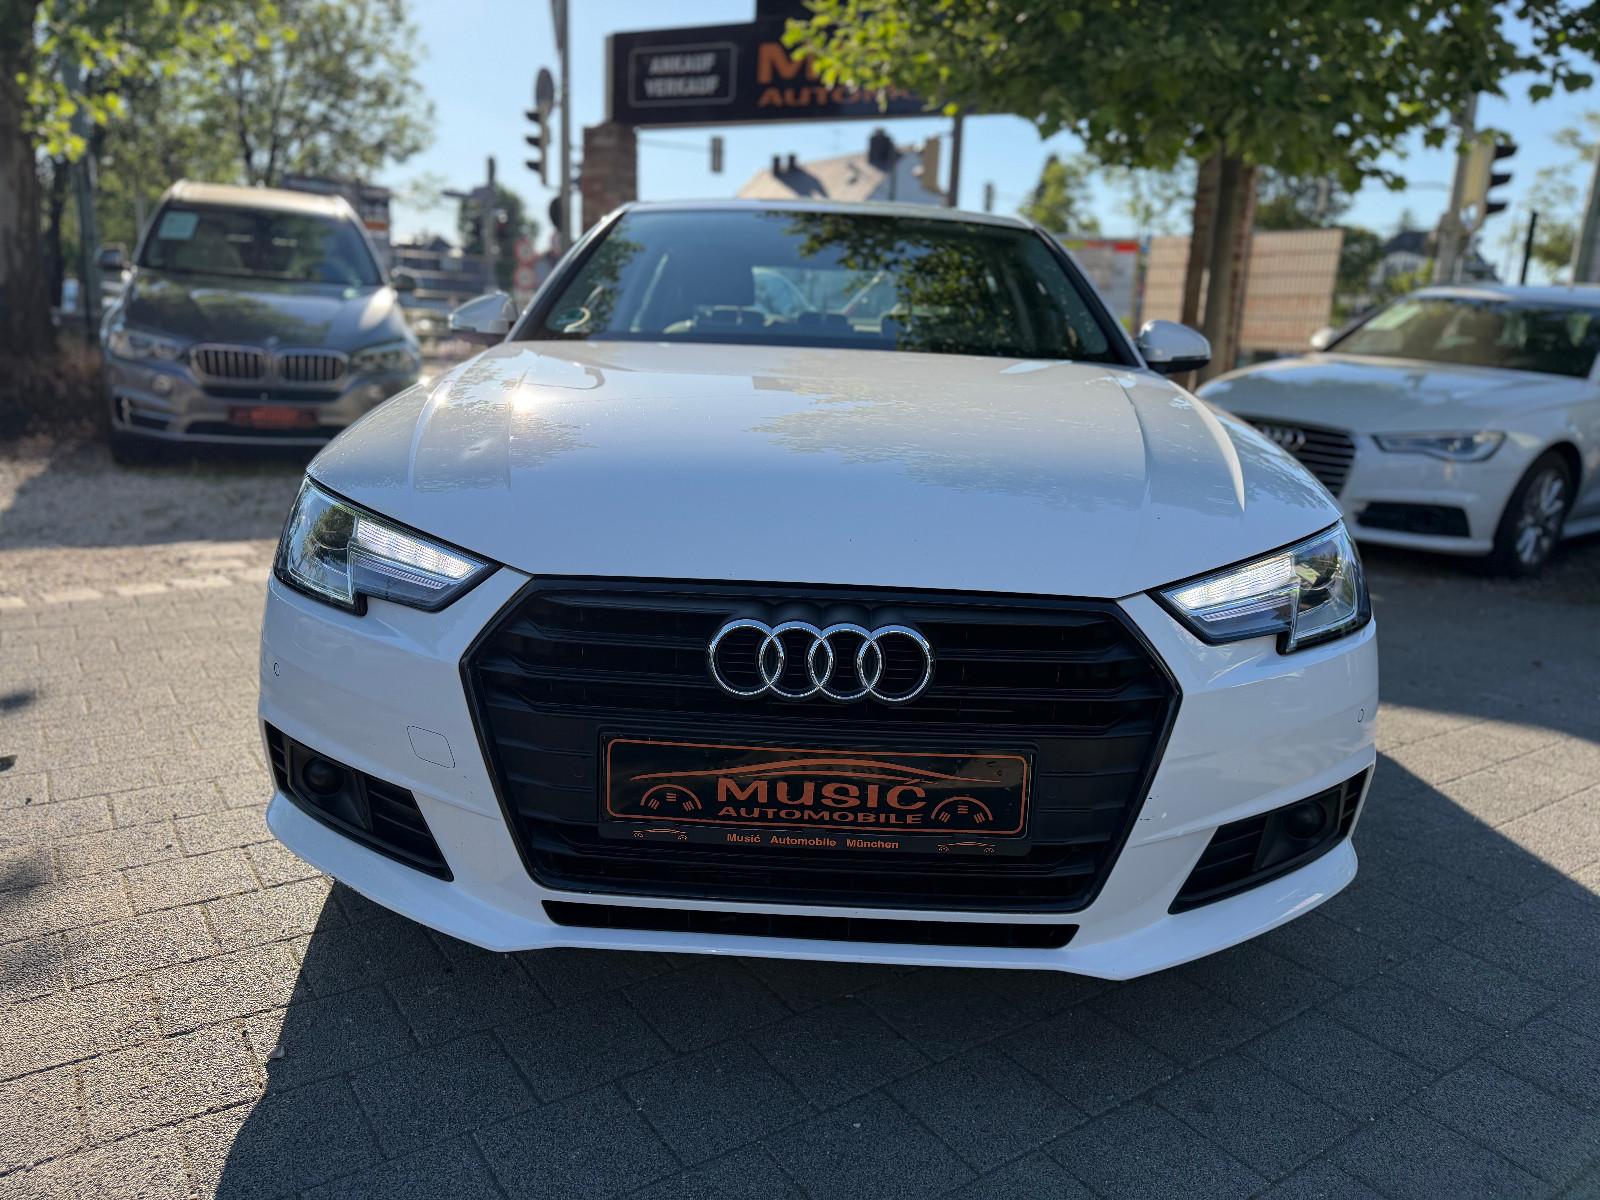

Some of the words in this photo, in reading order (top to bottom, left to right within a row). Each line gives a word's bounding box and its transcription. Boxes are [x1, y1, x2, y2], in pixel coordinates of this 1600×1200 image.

[718, 806, 923, 824] AUTOMOBILE
[726, 832, 761, 844] Musić
[769, 835, 837, 848] Automobile
[846, 837, 899, 849] München
